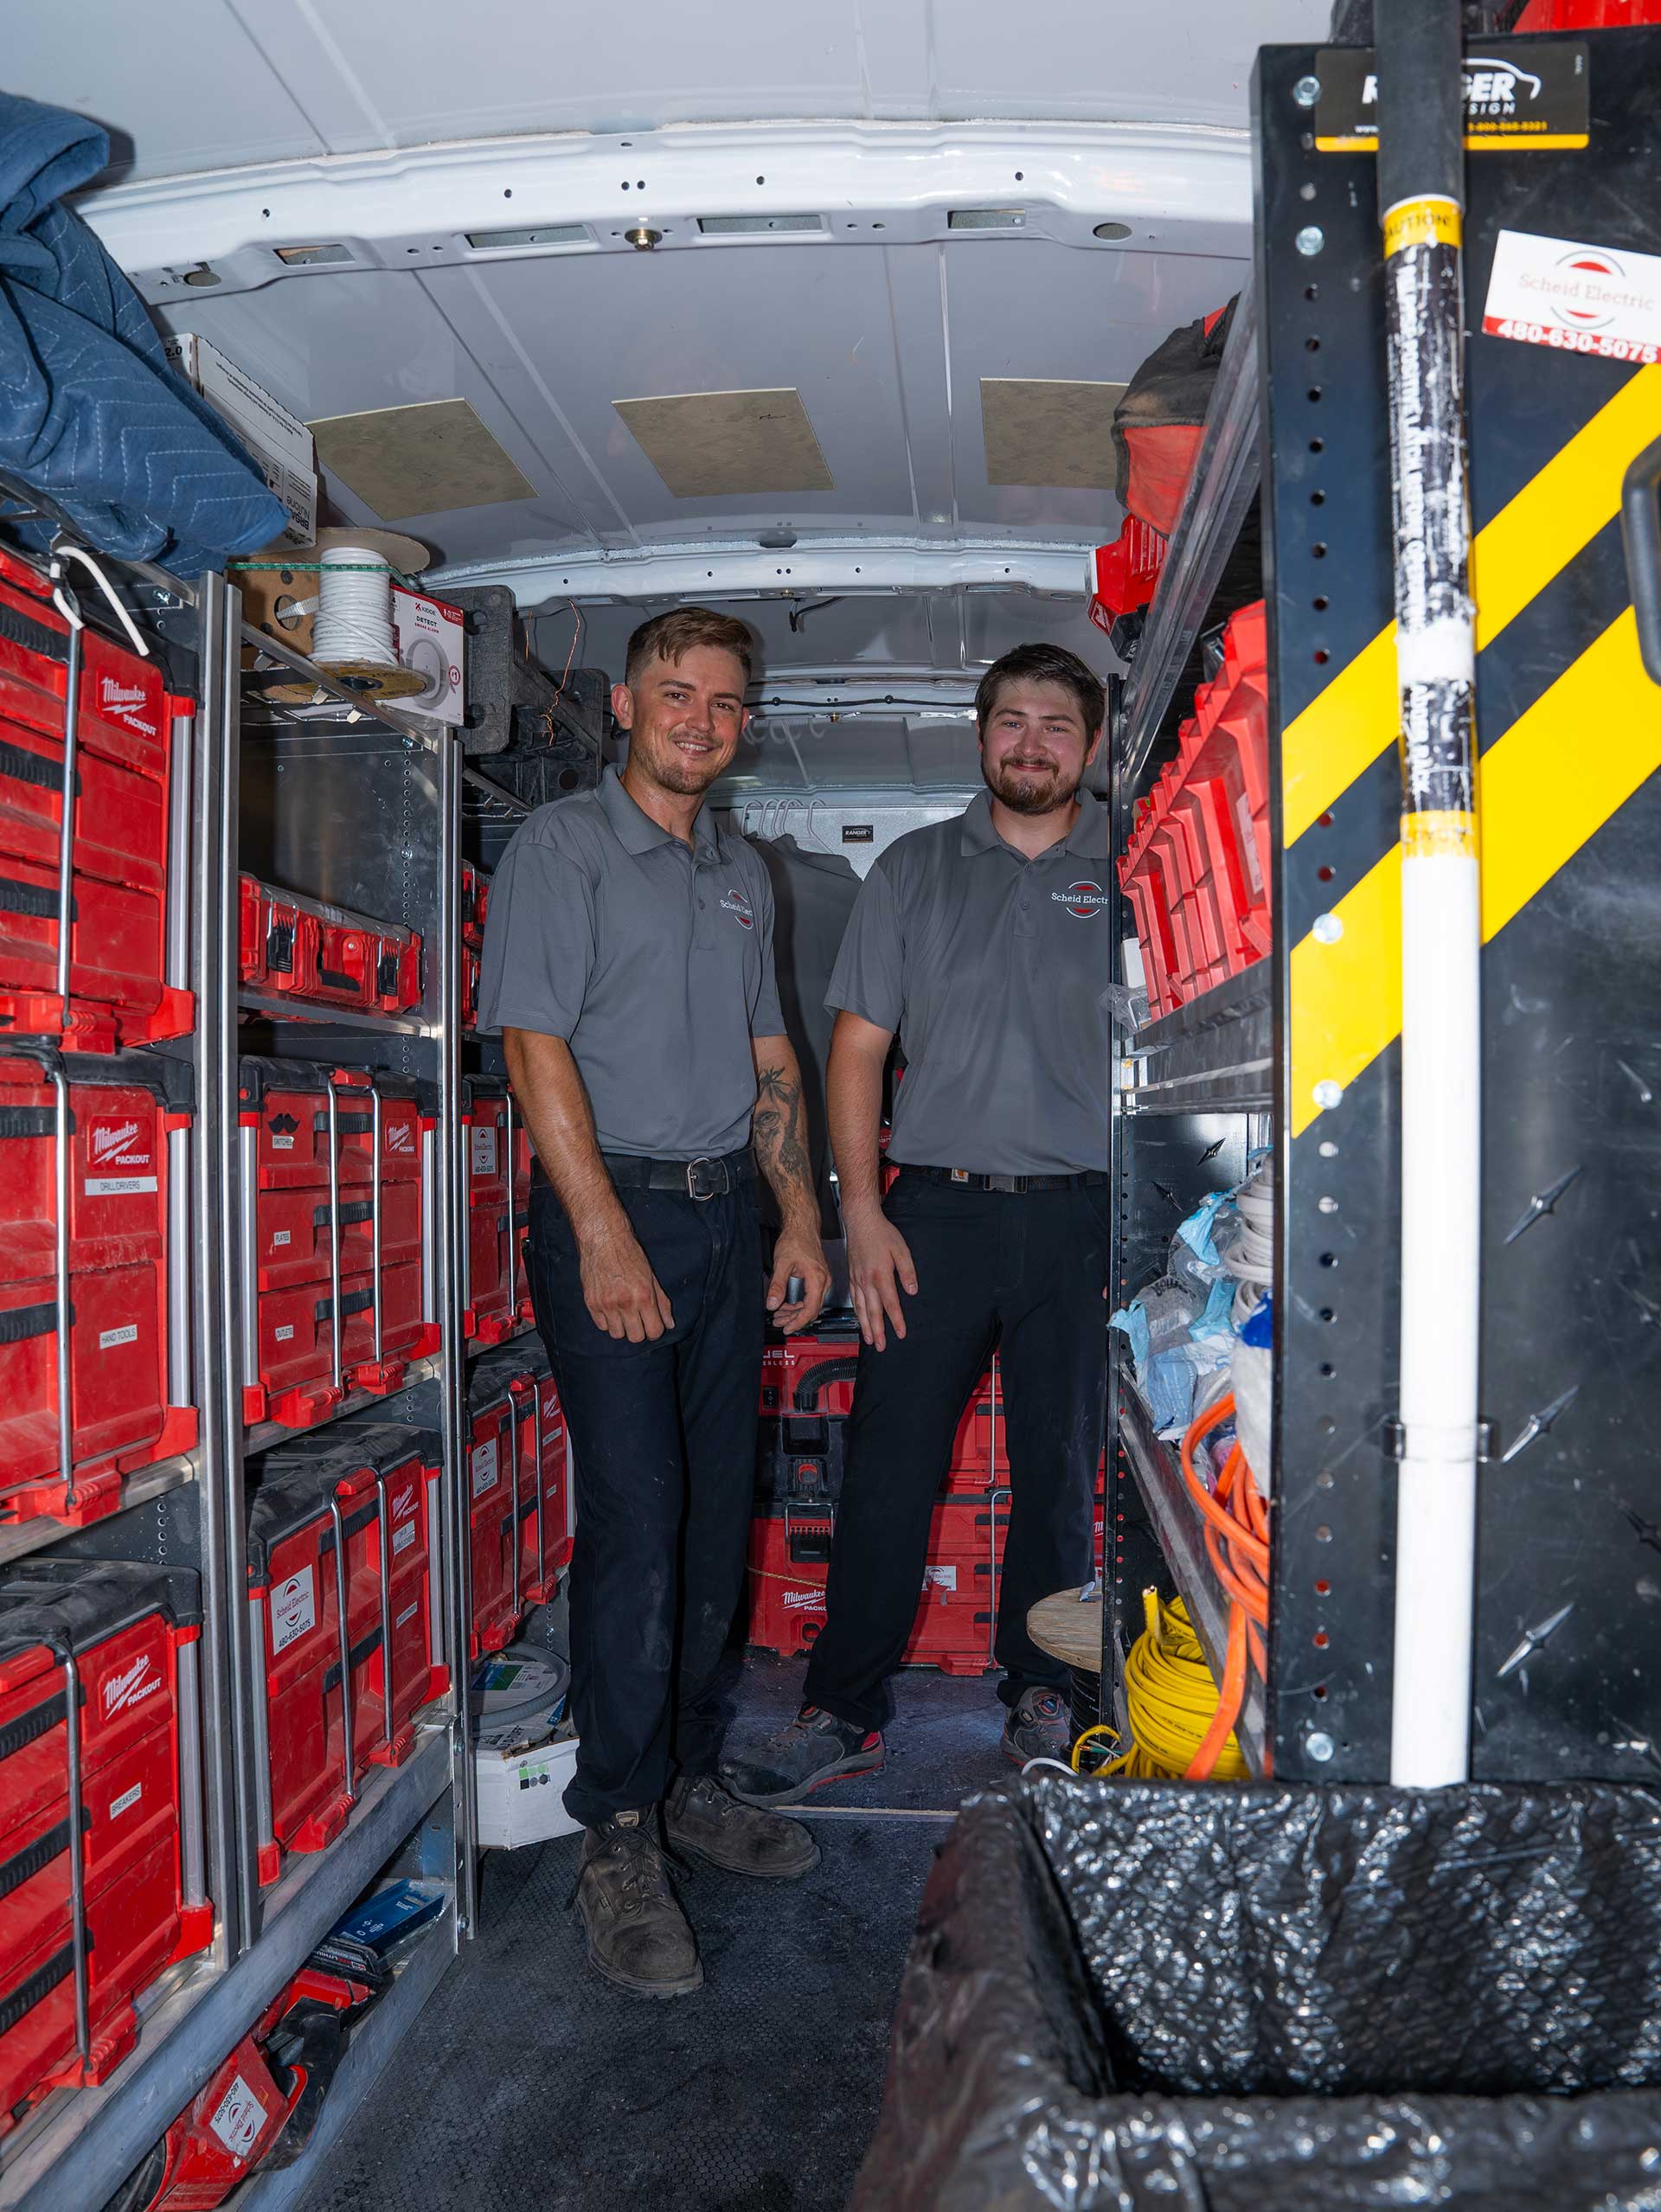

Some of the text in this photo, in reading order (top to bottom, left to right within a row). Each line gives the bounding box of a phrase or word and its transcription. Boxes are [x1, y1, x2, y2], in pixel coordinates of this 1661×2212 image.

[1466, 102, 1516, 115] SIGN
[1384, 212, 1449, 237] AUTION
[1520, 273, 1655, 311] Scheid Electric
[1497, 319, 1658, 364] 480-630-5075
[290, 509, 310, 530] BROA
[416, 615, 438, 627] DETECT
[101, 676, 146, 702] Milwaukee
[123, 714, 157, 736] PACKOUT
[1410, 683, 1429, 742] ADDER
[1051, 892, 1108, 905] Scheid Electr
[92, 1121, 138, 1155] Milwaukee
[115, 1155, 150, 1165] PACKOUT
[276, 1232, 290, 1242] PLATES
[101, 1328, 136, 1343] HAND TOOLS
[762, 1350, 795, 1358] UEL
[277, 1591, 310, 1619] Scheid Electric
[782, 1589, 826, 1605] Milwaukee
[279, 1619, 311, 1647] 480-630-5075
[103, 1654, 151, 1709] Milwaukee
[127, 1677, 162, 1707] PACKOUT
[112, 1786, 140, 1815] BREAKERS
[214, 2081, 240, 2124] 480-630-5075
